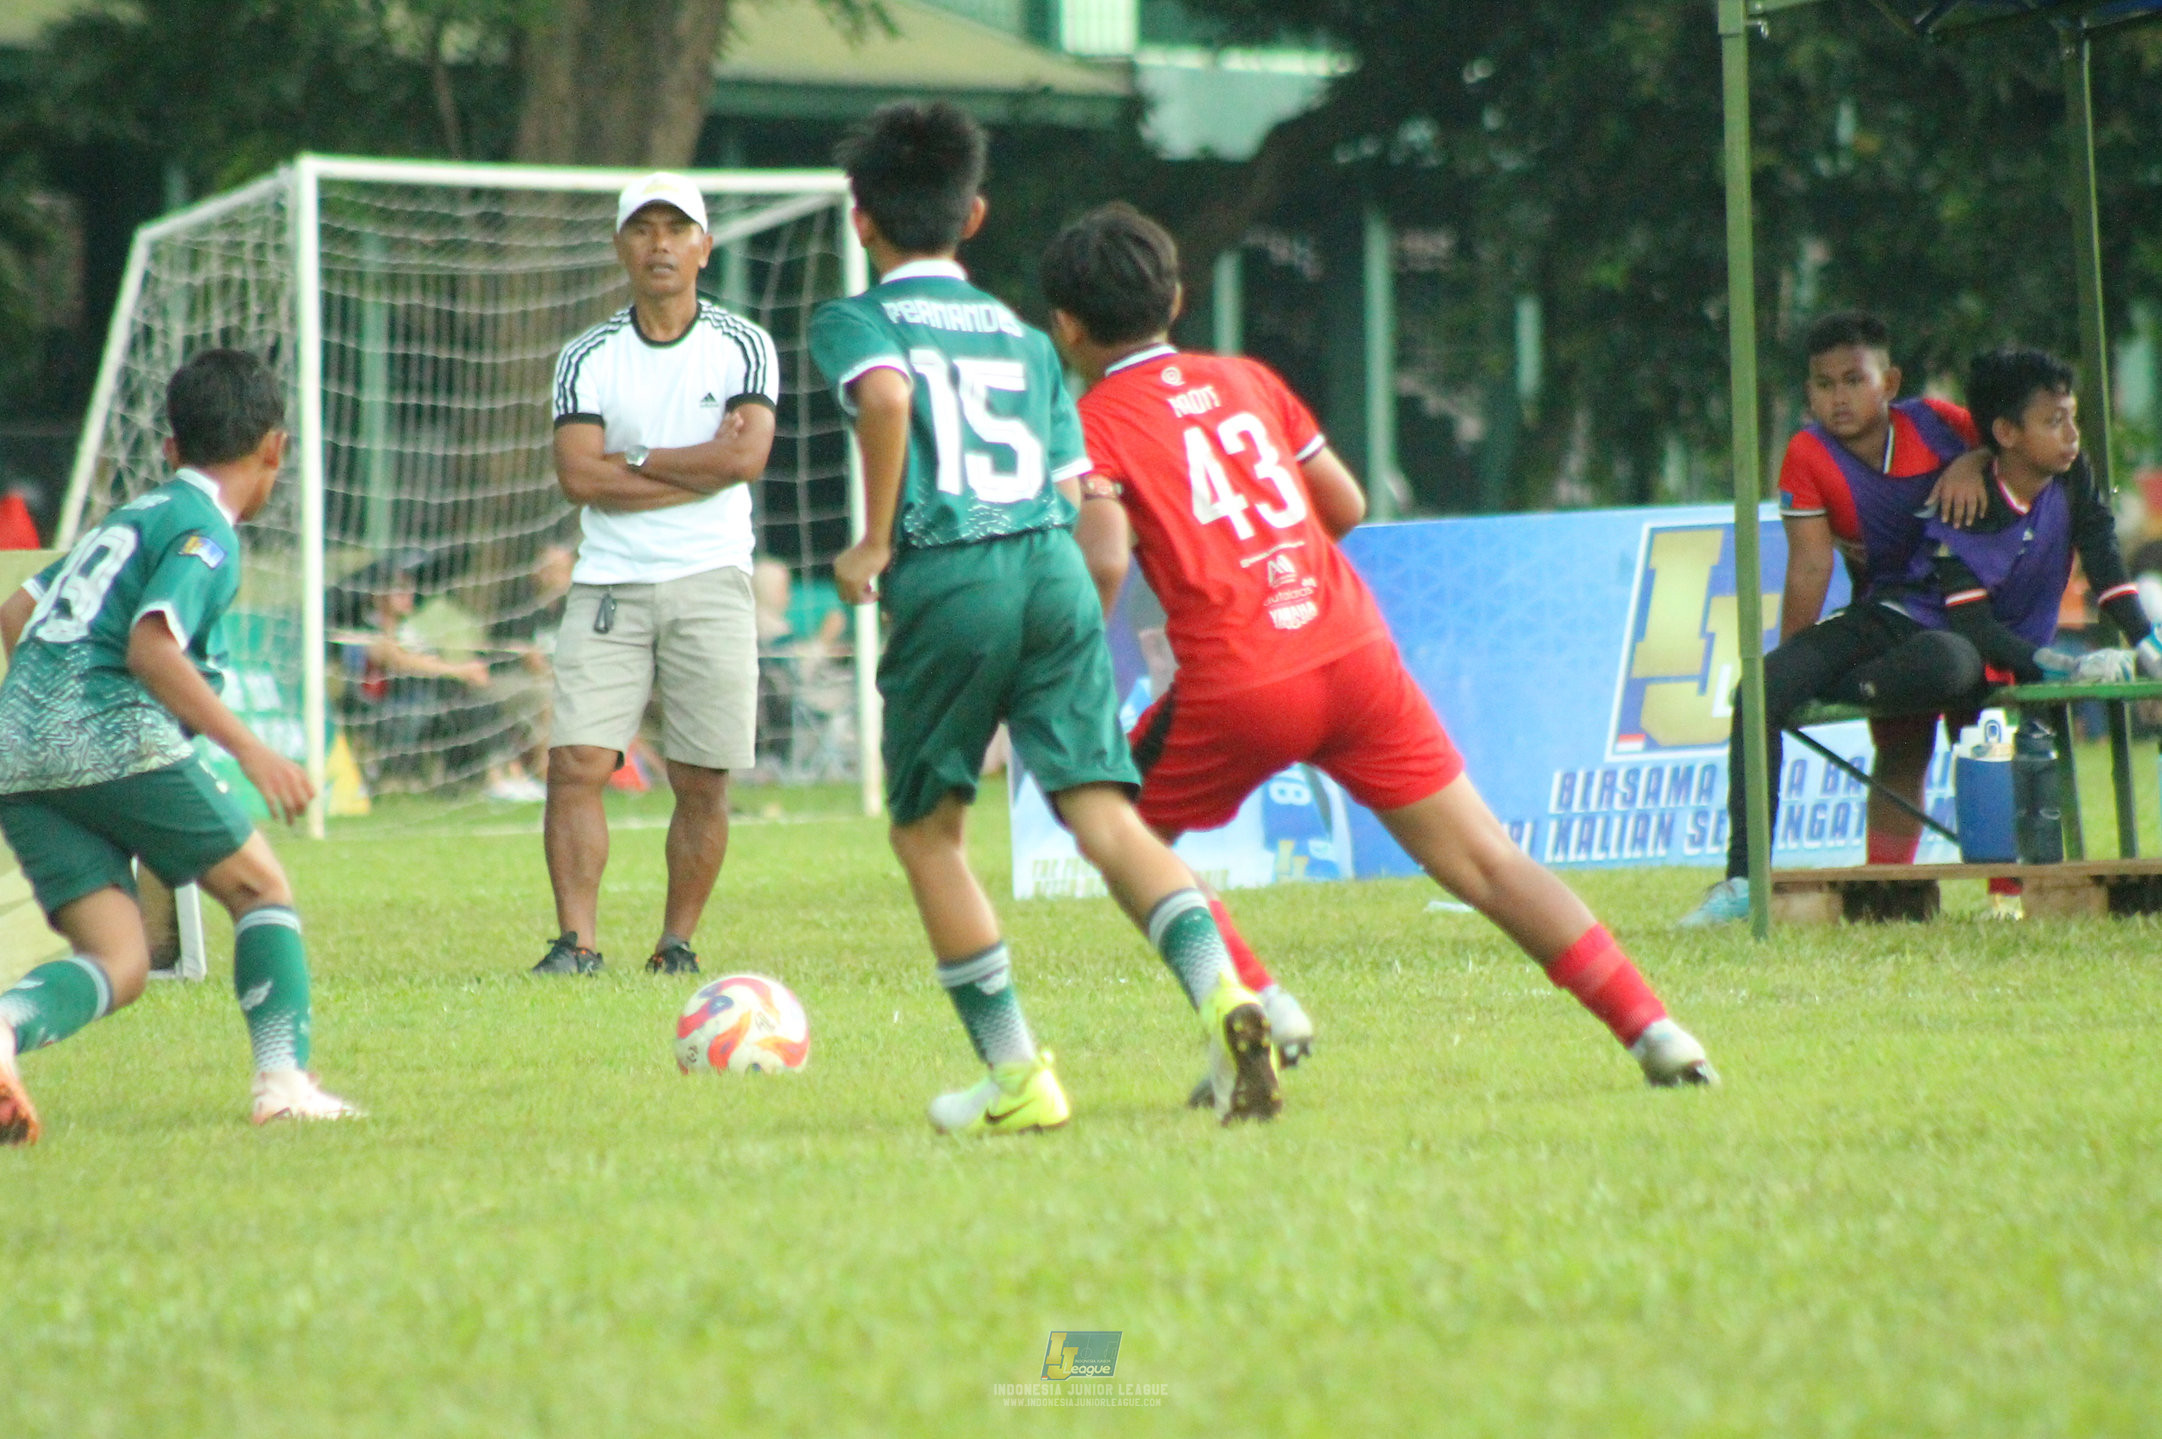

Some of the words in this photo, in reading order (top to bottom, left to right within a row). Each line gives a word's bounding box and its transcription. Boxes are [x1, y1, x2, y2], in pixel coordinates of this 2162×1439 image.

[909, 348, 1044, 503] 15
[1183, 411, 1307, 540] 43
[1549, 764, 1718, 814] BERSAMA
[1545, 810, 1676, 863] KALIAN
